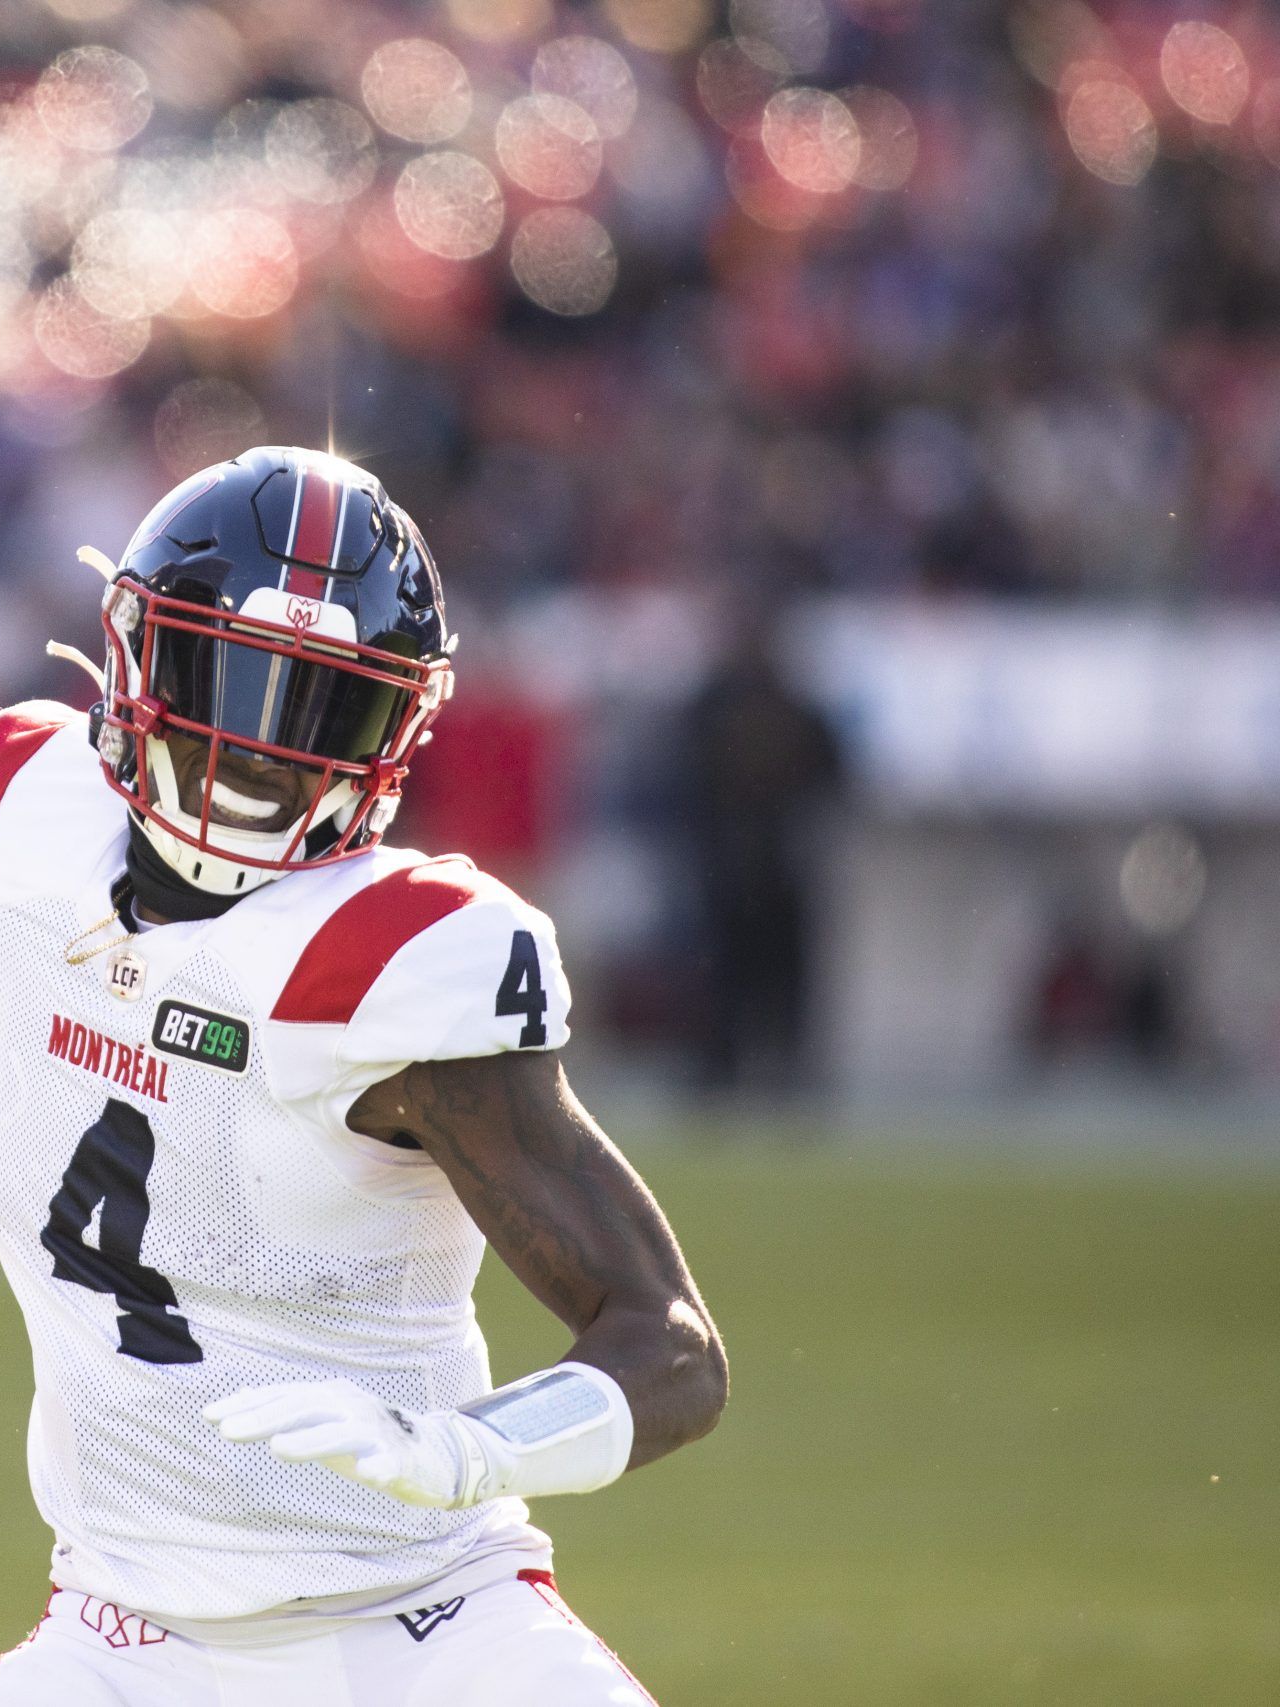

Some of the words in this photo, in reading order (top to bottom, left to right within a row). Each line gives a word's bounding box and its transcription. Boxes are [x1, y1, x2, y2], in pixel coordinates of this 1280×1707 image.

[111, 963, 139, 988] LCF
[495, 930, 547, 1048] 4
[47, 1013, 168, 1103] MONTRÉAL
[160, 1008, 236, 1060] BET99
[40, 1096, 203, 1364] 4
